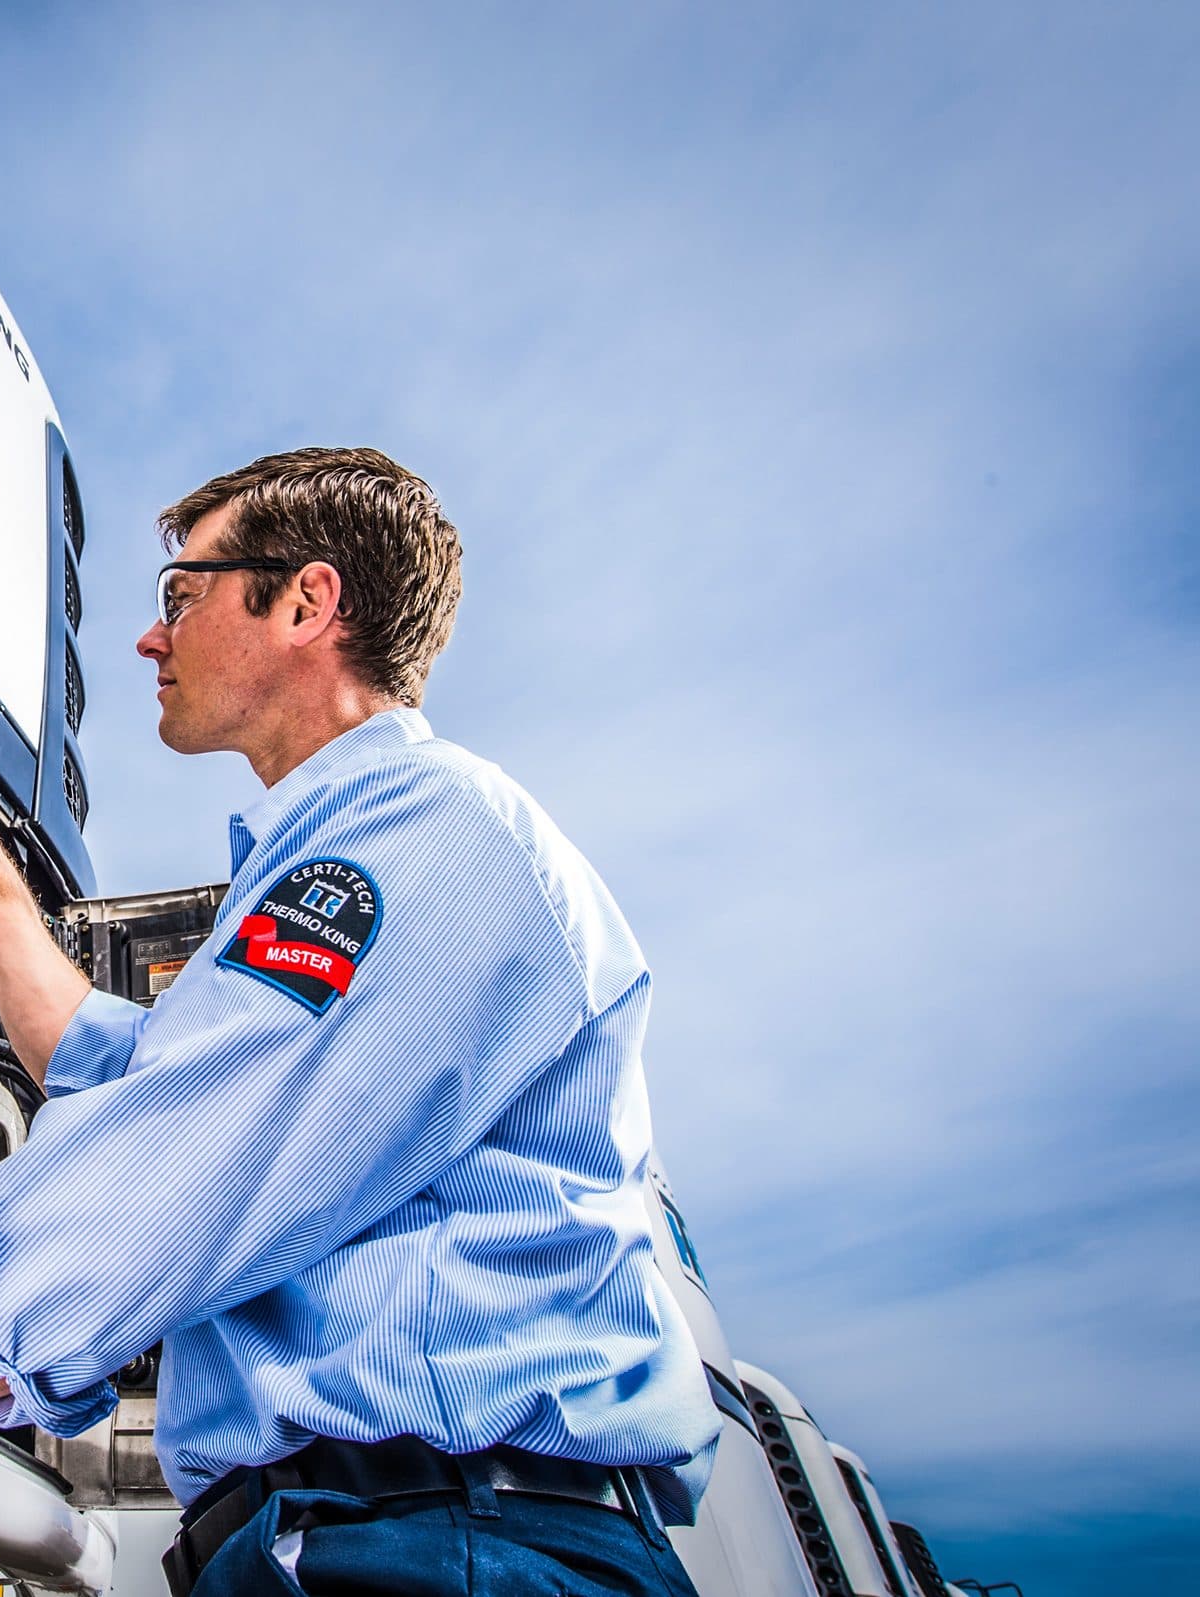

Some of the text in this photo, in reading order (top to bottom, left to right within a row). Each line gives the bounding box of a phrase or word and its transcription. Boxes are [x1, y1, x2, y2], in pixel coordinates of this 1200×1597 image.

[290, 863, 374, 914] CERTI-TECH
[261, 900, 361, 954] THERMO KING
[266, 947, 333, 973] MASTER
